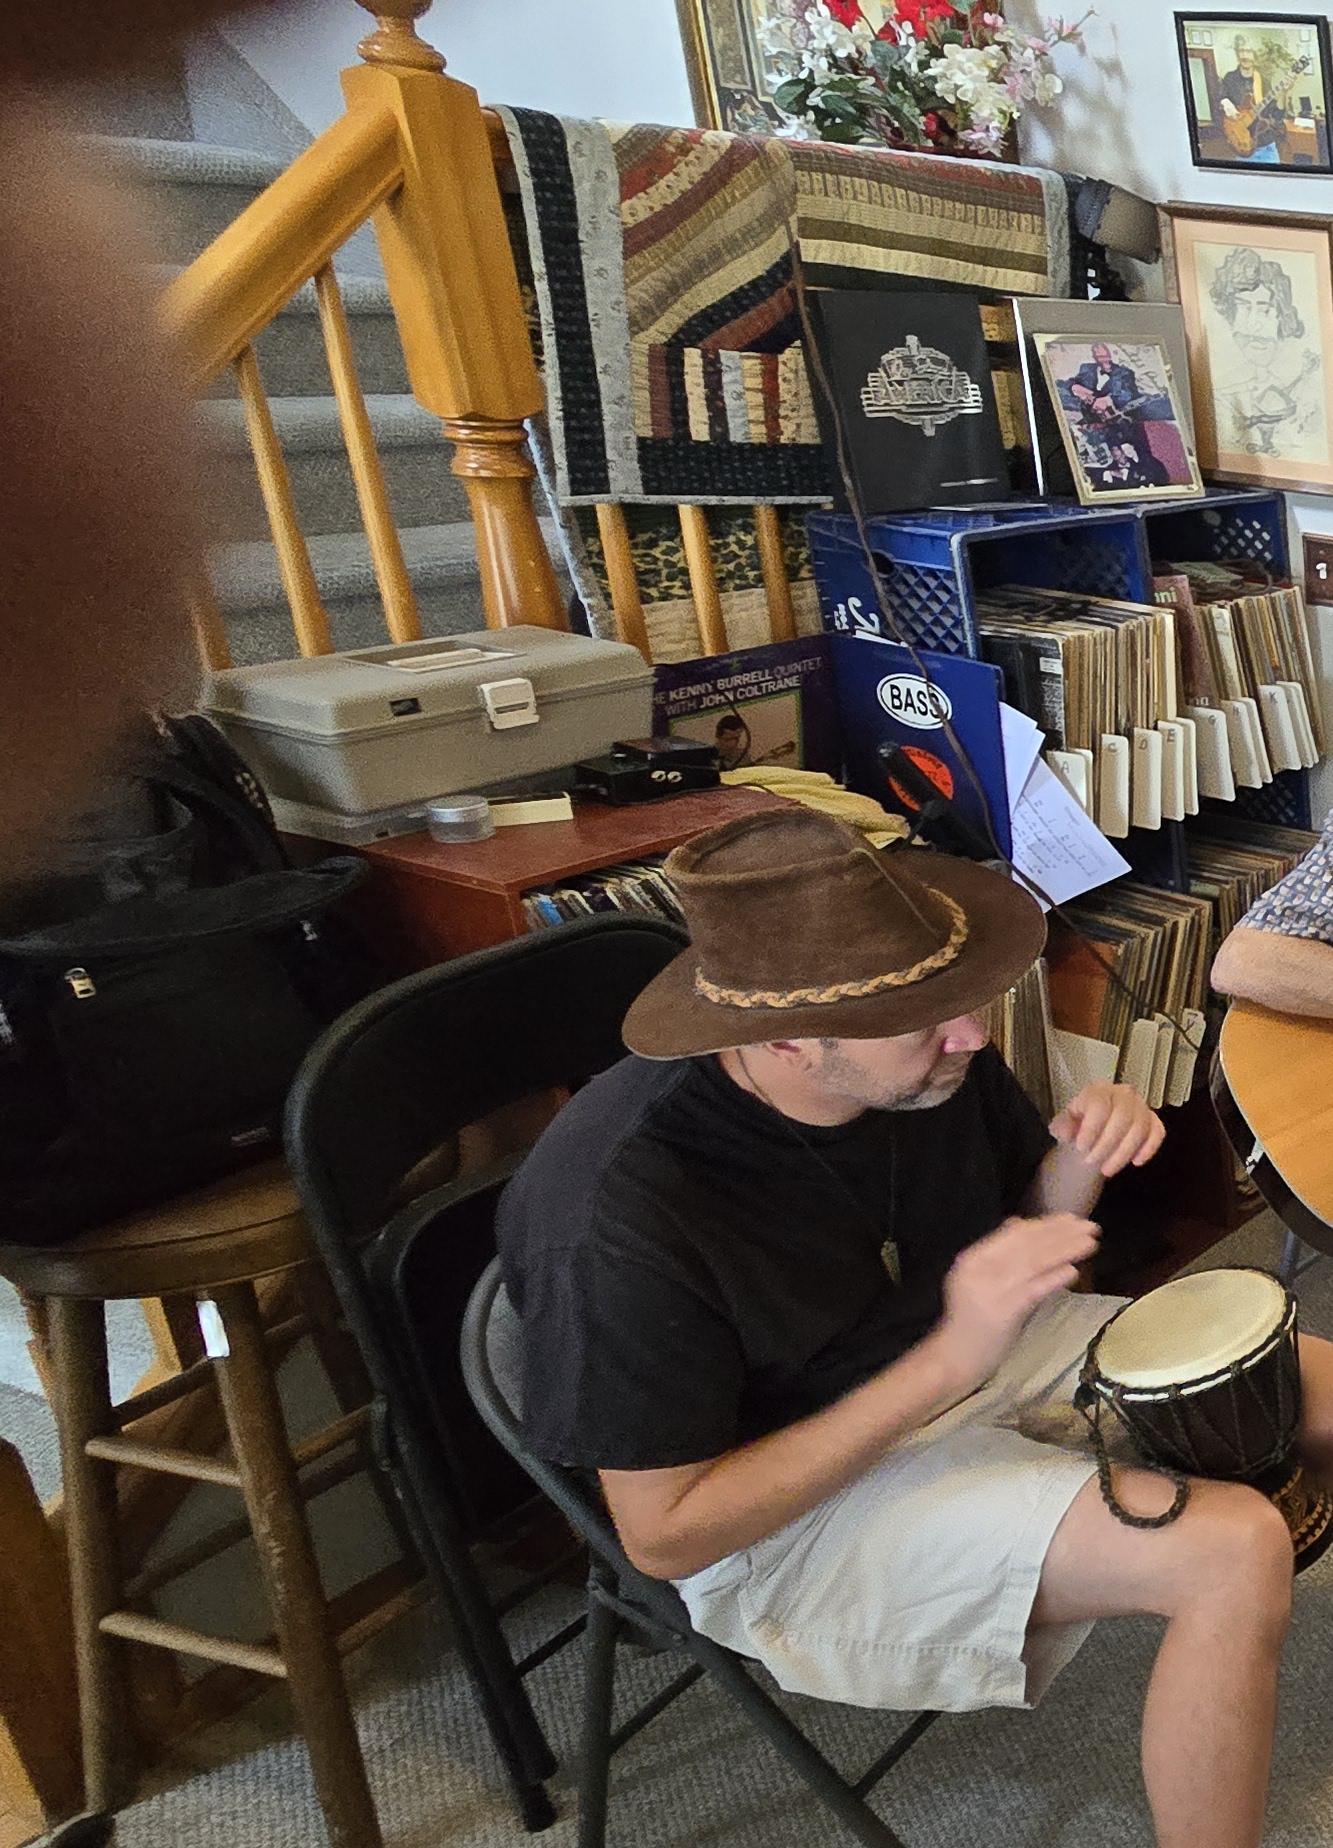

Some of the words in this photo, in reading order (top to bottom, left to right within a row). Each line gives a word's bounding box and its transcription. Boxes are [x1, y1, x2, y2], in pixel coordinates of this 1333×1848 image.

[652, 692, 666, 705] HE
[669, 679, 715, 701] KENNY
[716, 669, 773, 690] BURRELL
[773, 656, 822, 679] QUINTET
[665, 700, 697, 716] WITH
[699, 690, 735, 709] JOHN
[736, 675, 801, 699] COLTRANE
[1139, 738, 1149, 750] D
[1166, 728, 1176, 742] E
